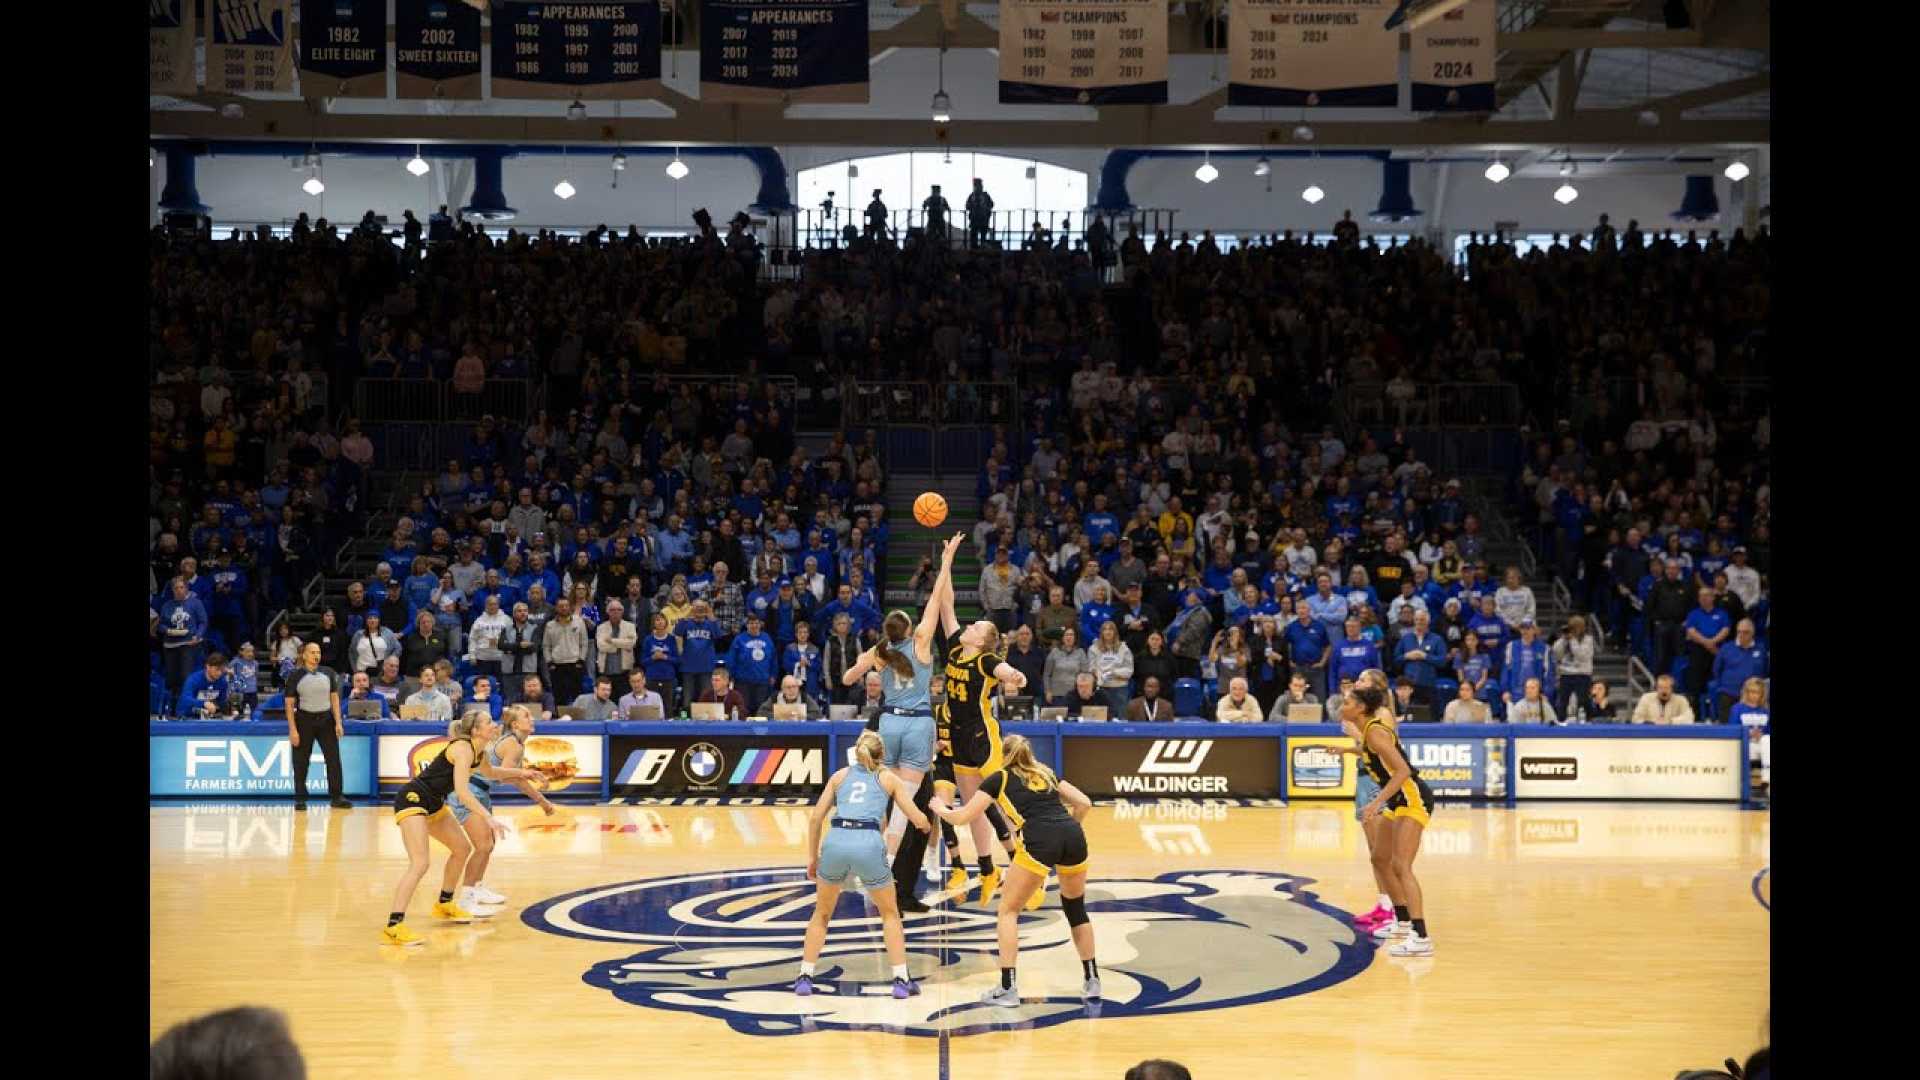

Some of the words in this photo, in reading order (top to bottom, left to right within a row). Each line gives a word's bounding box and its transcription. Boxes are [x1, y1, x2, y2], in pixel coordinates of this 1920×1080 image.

[543, 5, 625, 19] APPEARANCES
[751, 10, 833, 24] APPEARANCES
[1063, 12, 1128, 24] CHAMPIONS
[1293, 13, 1358, 25] CHAMPIONS
[328, 27, 360, 43] 1982
[514, 23, 540, 36] 1982
[564, 24, 589, 36] 1995
[613, 24, 639, 37] 2000
[721, 27, 747, 40] 2007
[772, 29, 798, 41] 2019
[1250, 31, 1276, 42] 2018
[1302, 31, 1328, 42] 2024
[421, 29, 455, 45] 2002
[311, 48, 343, 61] ELITE
[344, 48, 376, 61] EIGHT
[399, 50, 433, 63] SWEET
[436, 50, 479, 63] SIXTEEN
[564, 44, 589, 57] 1997
[613, 43, 638, 55] 2001
[722, 47, 747, 59] 2017
[771, 47, 798, 59] 2023
[1250, 49, 1276, 61] 2019
[514, 62, 540, 74] 1986
[564, 62, 589, 74] 1998
[613, 62, 639, 74] 2002
[722, 66, 748, 78] 2018
[771, 66, 799, 78] 2024
[1070, 66, 1094, 78] 2001
[1119, 66, 1143, 78] 2017
[1250, 67, 1277, 79] 2023
[1434, 62, 1473, 78] 2024
[945, 663, 969, 681] IOWA
[947, 679, 968, 702] 44
[1523, 763, 1575, 775] WEITZ
[1609, 764, 1642, 775] BUILD
[1656, 764, 1698, 775] BETTER
[185, 779, 243, 790] FARMERS
[1113, 776, 1228, 793] WALDINGER
[849, 781, 867, 804] 2
